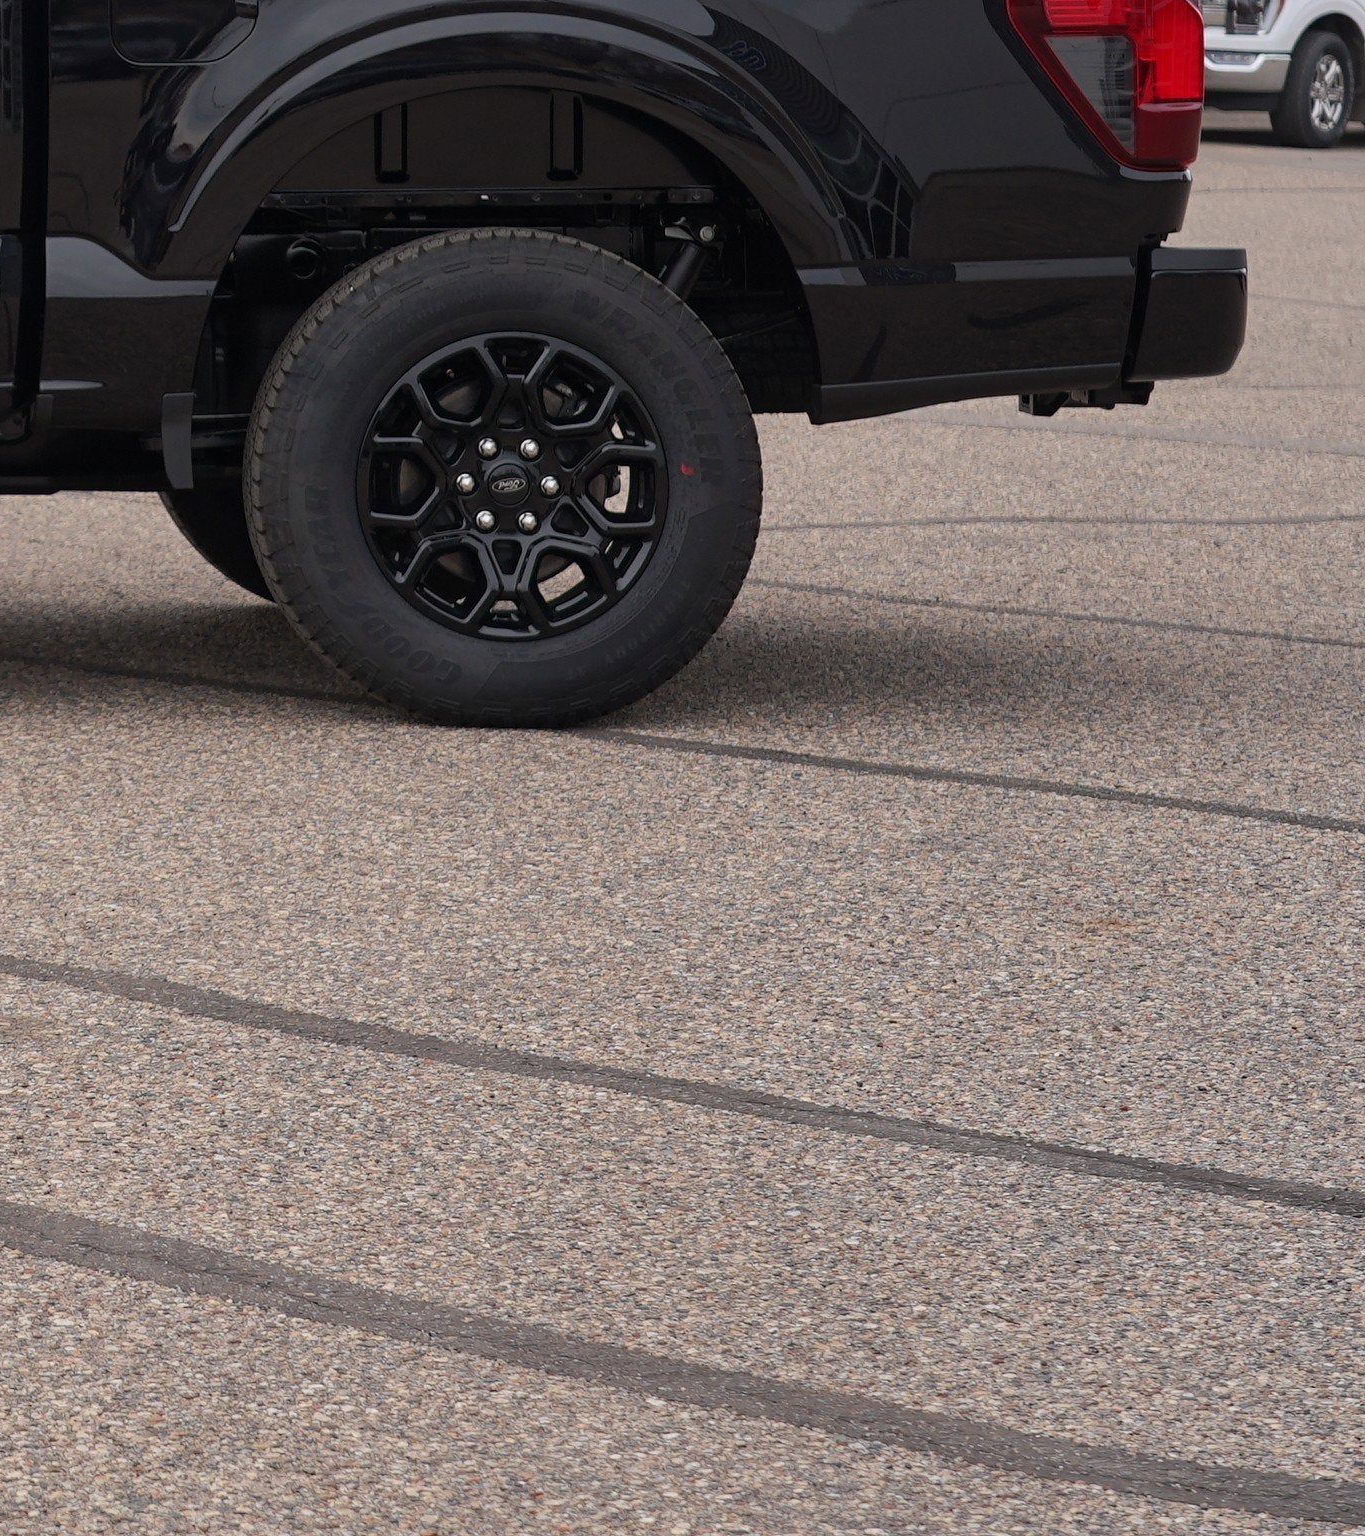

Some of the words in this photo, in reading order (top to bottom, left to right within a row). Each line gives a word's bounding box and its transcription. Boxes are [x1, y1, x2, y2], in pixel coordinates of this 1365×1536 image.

[572, 288, 723, 483] WRANGLER
[498, 479, 520, 491] Ford
[305, 486, 462, 685] GOODYEAR
